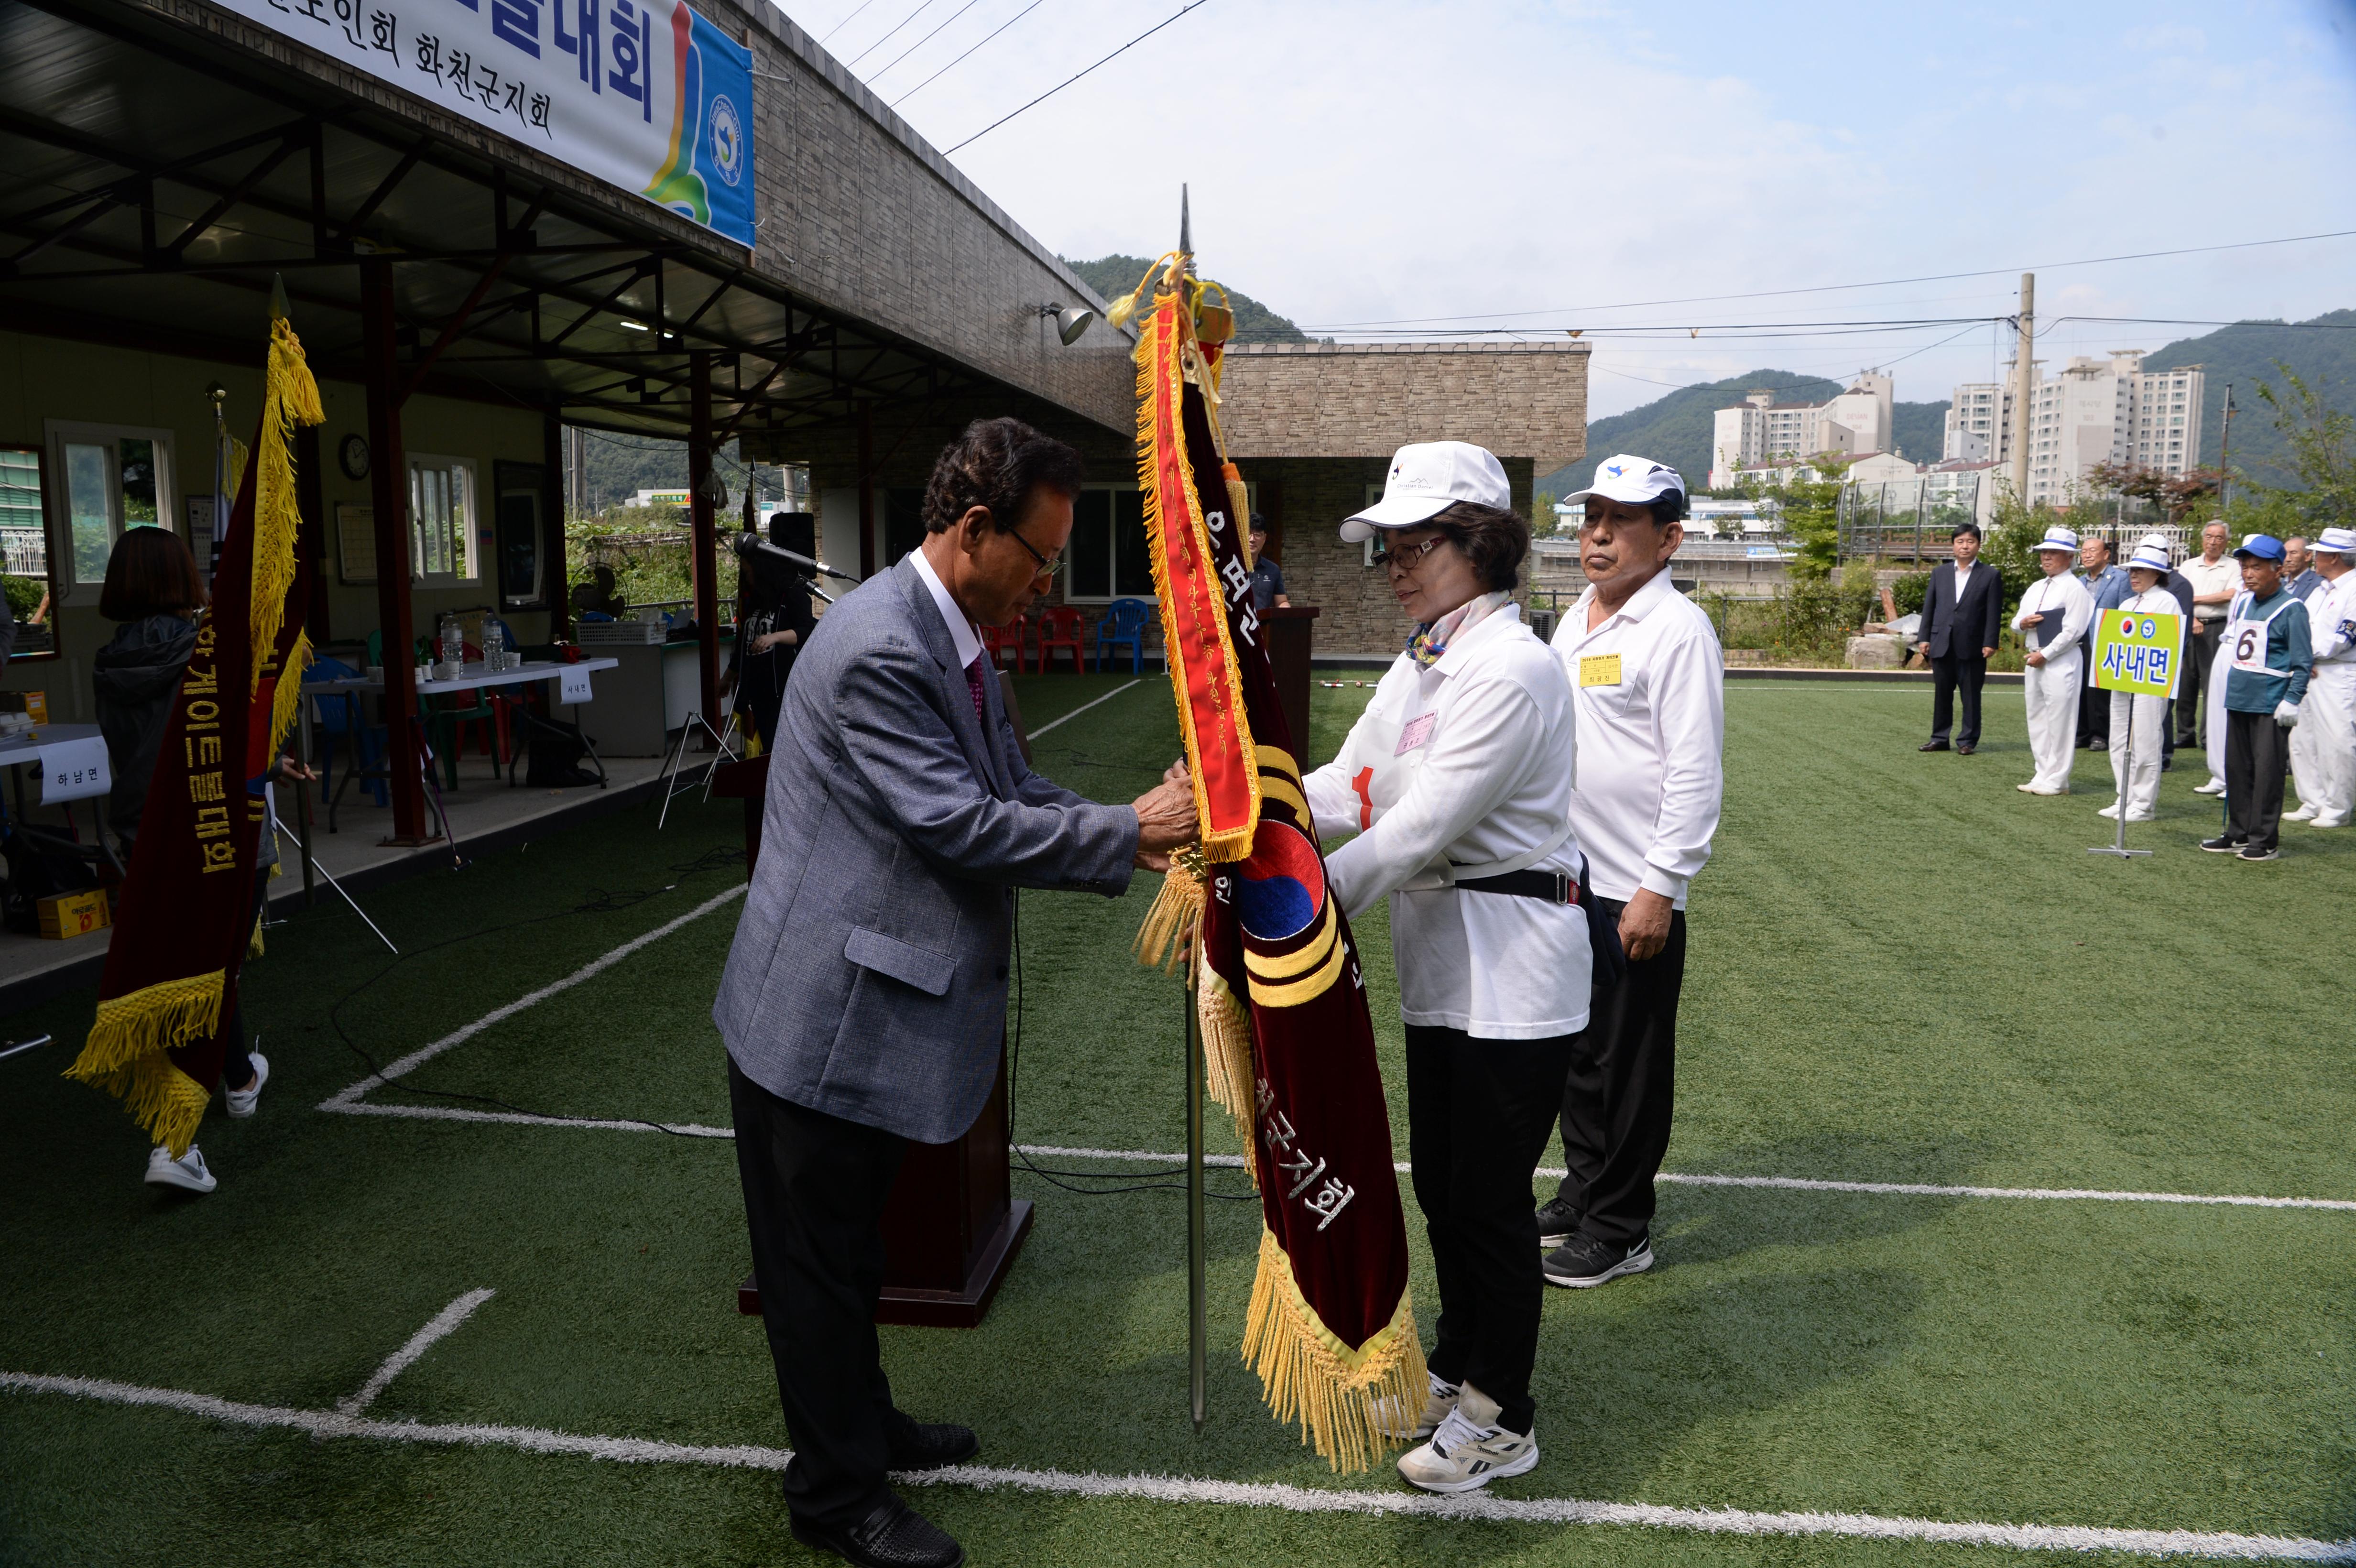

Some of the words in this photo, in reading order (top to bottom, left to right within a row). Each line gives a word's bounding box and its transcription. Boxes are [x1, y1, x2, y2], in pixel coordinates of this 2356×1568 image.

[415, 33, 552, 140] 화천군지회
[2236, 629, 2257, 661] 6
[2103, 644, 2169, 683] 사내면
[1477, 1445, 1499, 1455] Reebok
